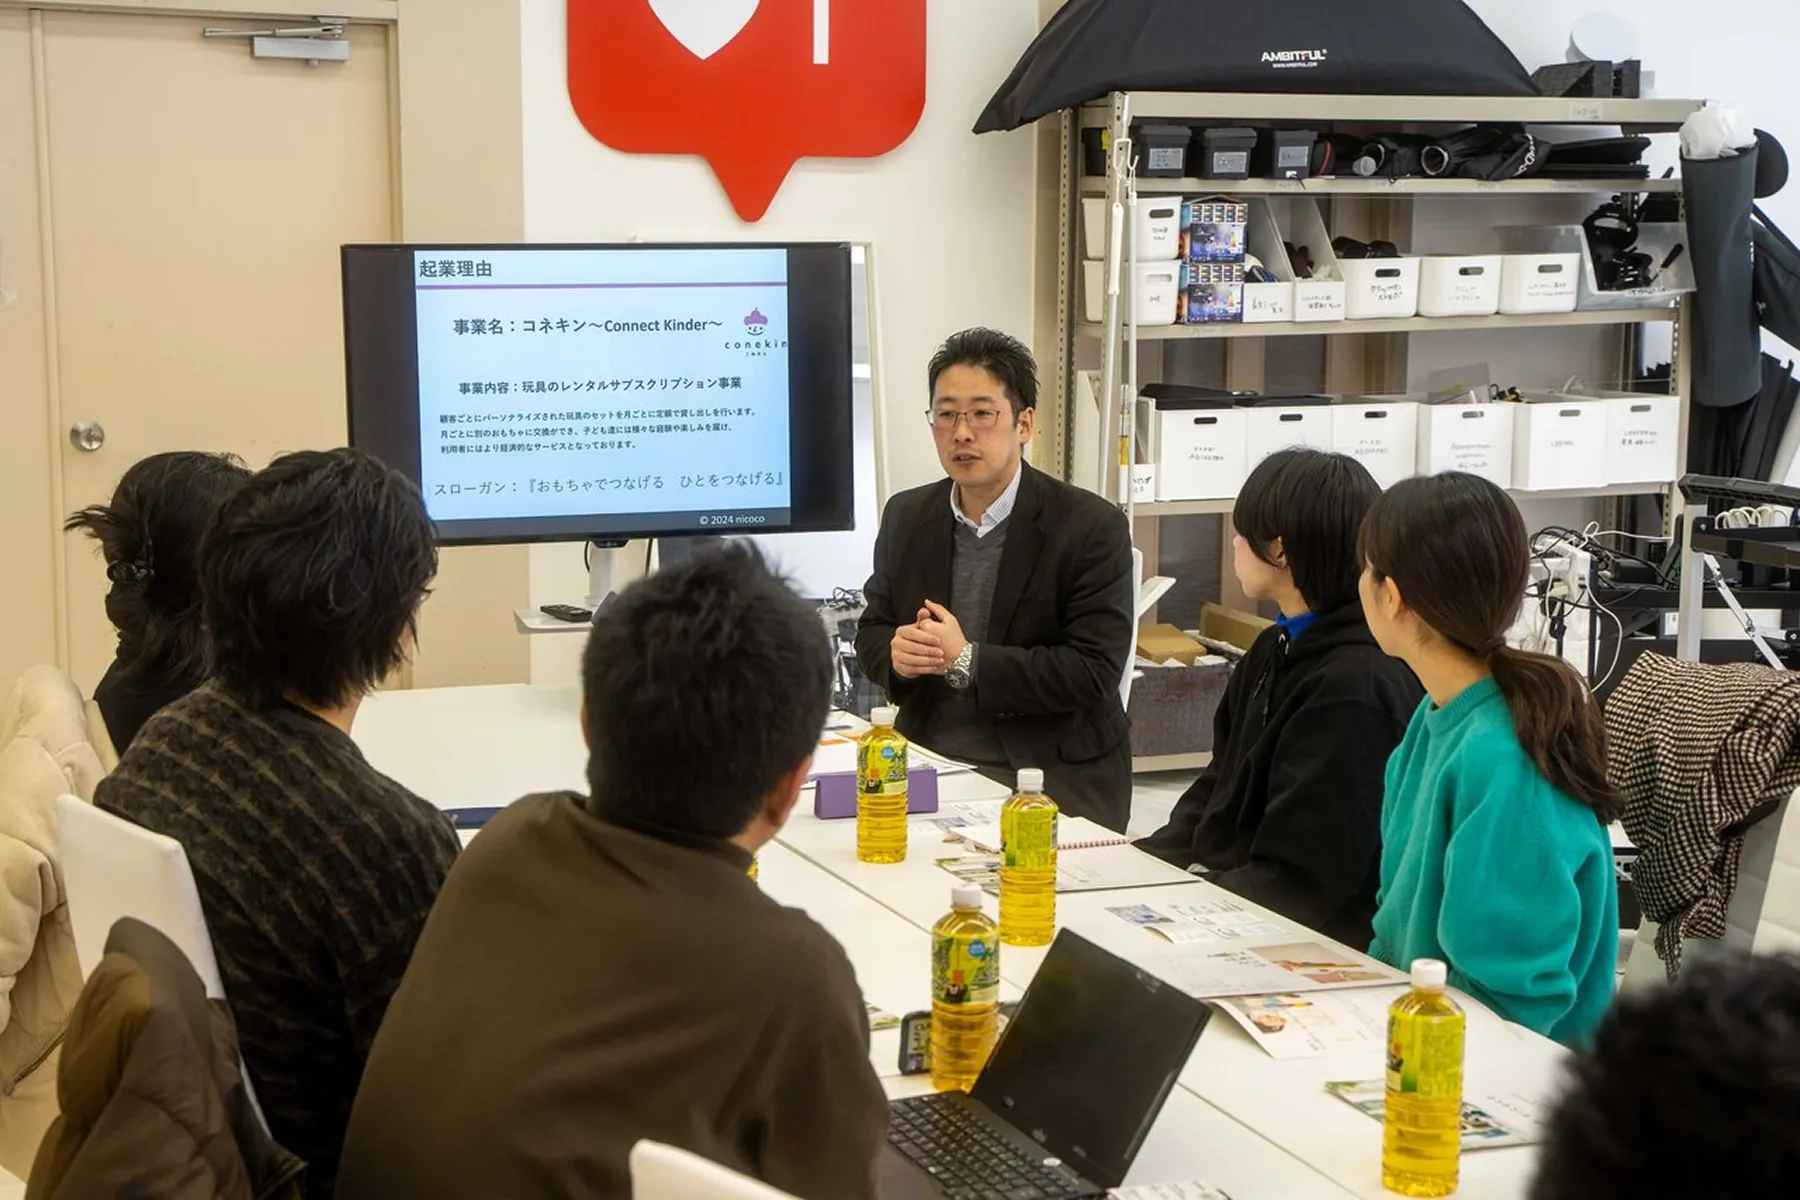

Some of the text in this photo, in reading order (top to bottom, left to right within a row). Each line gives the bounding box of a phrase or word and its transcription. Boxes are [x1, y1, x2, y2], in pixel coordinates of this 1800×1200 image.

[419, 259, 492, 278] 起業理由
[724, 339, 788, 350] conekin
[458, 376, 743, 395] 事業内容：玩具のレンタルサブスクリプション事業
[680, 470, 784, 489] ひとをつなげる』
[711, 515, 734, 525] 2024
[735, 514, 766, 524] nicoco
